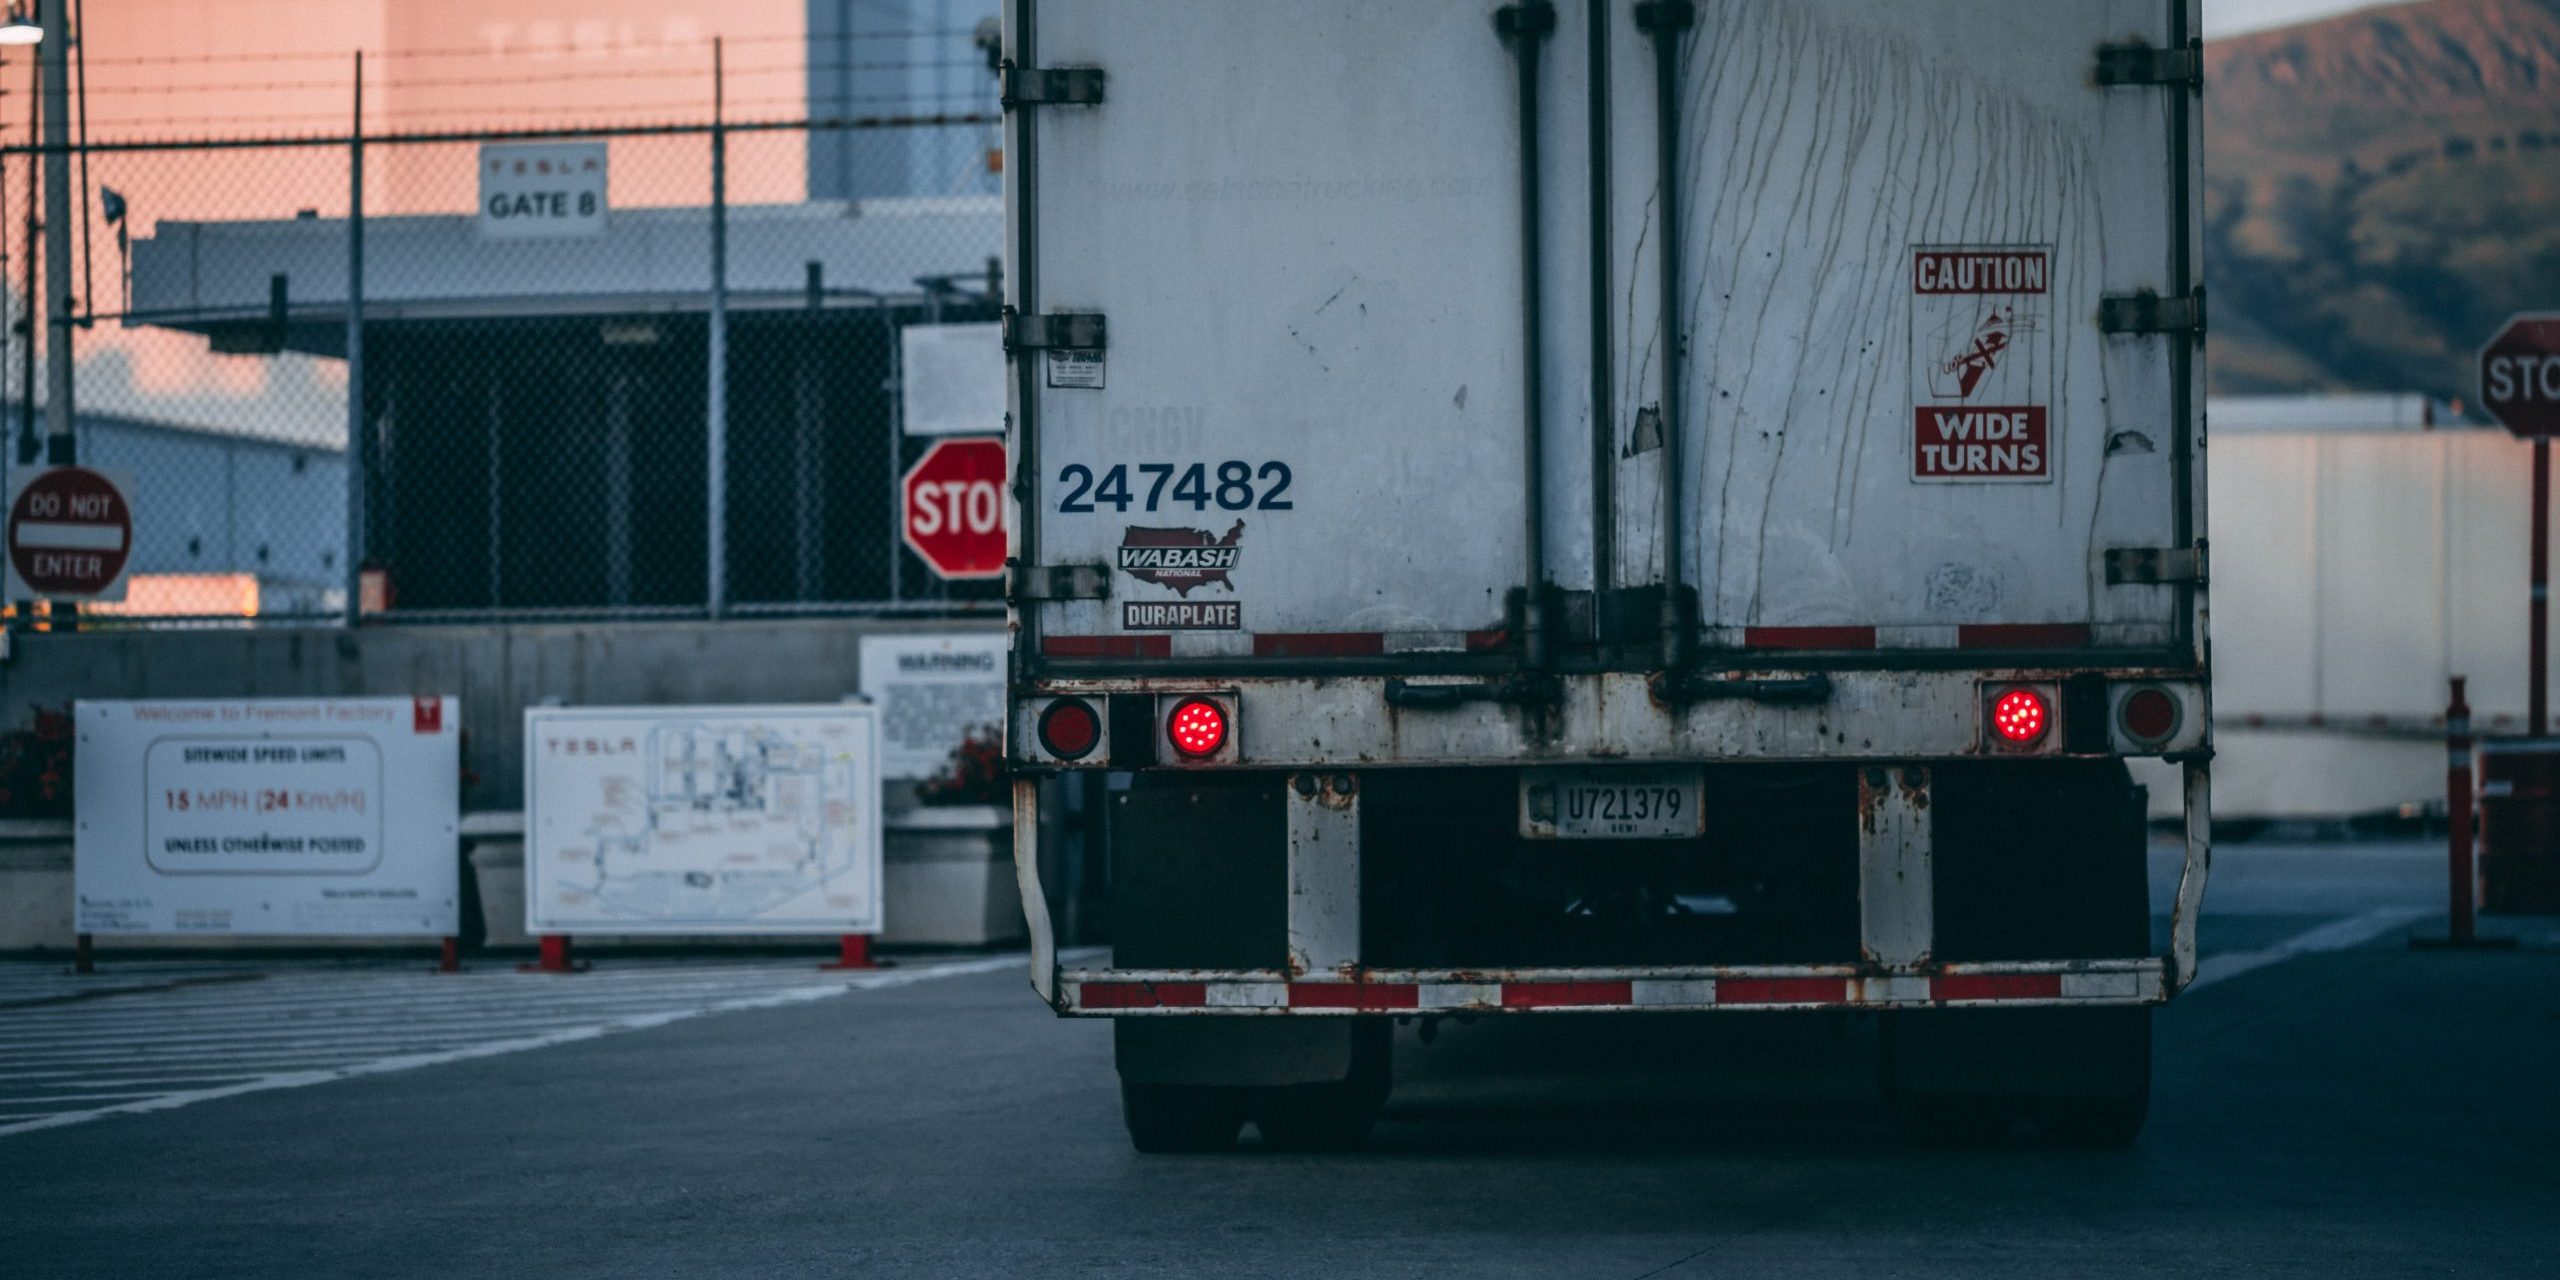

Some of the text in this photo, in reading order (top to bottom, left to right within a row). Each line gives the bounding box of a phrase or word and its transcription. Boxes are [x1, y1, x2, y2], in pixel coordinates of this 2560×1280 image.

[488, 190, 597, 219] GATE 8
[1918, 256, 2043, 291] CAUTION
[1934, 412, 2028, 441] WIDE
[1921, 443, 2041, 473] TURNS
[1059, 460, 1293, 513] 247482
[30, 492, 111, 519] DO NOT
[912, 481, 1007, 536] STO
[33, 555, 102, 578] ENTER
[1120, 549, 1239, 568] WABASH
[1155, 569, 1203, 578] NATIONAL
[1128, 605, 1236, 626] DURAPLATE
[134, 704, 215, 721] Welcome
[221, 705, 241, 721] to
[326, 704, 395, 723] Factory
[184, 747, 346, 763] SITEWIDE SPEED LIMITS
[166, 790, 190, 812] 15
[197, 790, 248, 812] MPH
[257, 789, 289, 815] (24
[1568, 787, 1681, 820] U721379
[165, 836, 366, 854] UNLESS OTHERWISE POSTED
